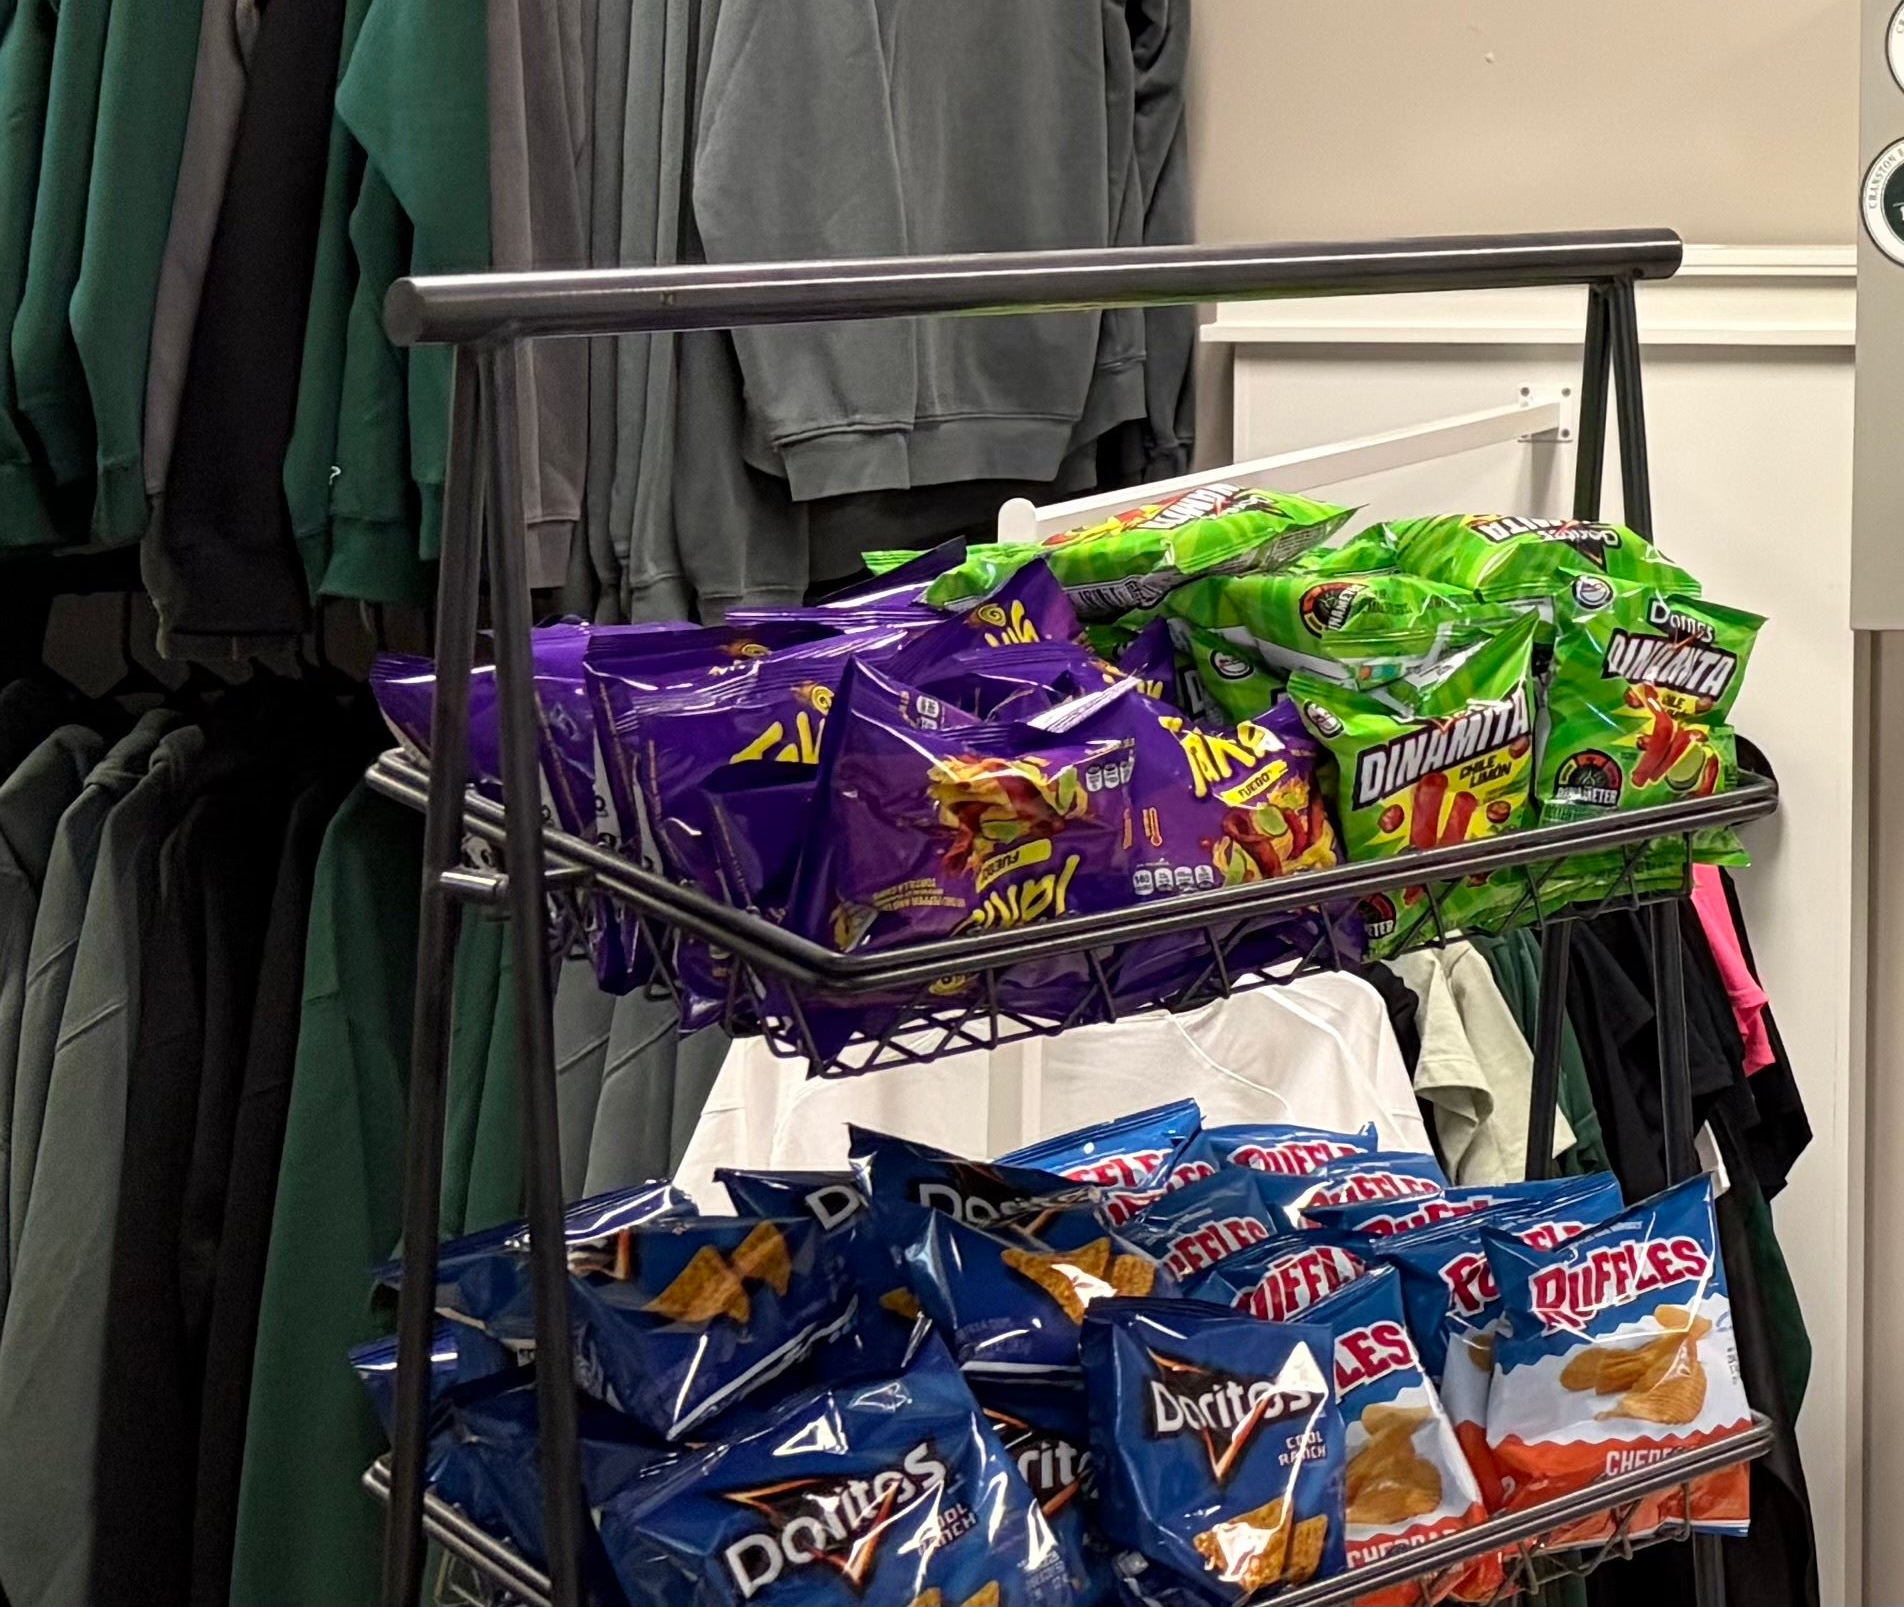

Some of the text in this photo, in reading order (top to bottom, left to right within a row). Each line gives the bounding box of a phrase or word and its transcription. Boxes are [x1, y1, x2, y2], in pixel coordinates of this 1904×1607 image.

[1358, 687, 1530, 804] DINAMITA
[1532, 1237, 1709, 1334] RUFFLES
[727, 1442, 948, 1599] Doritos
